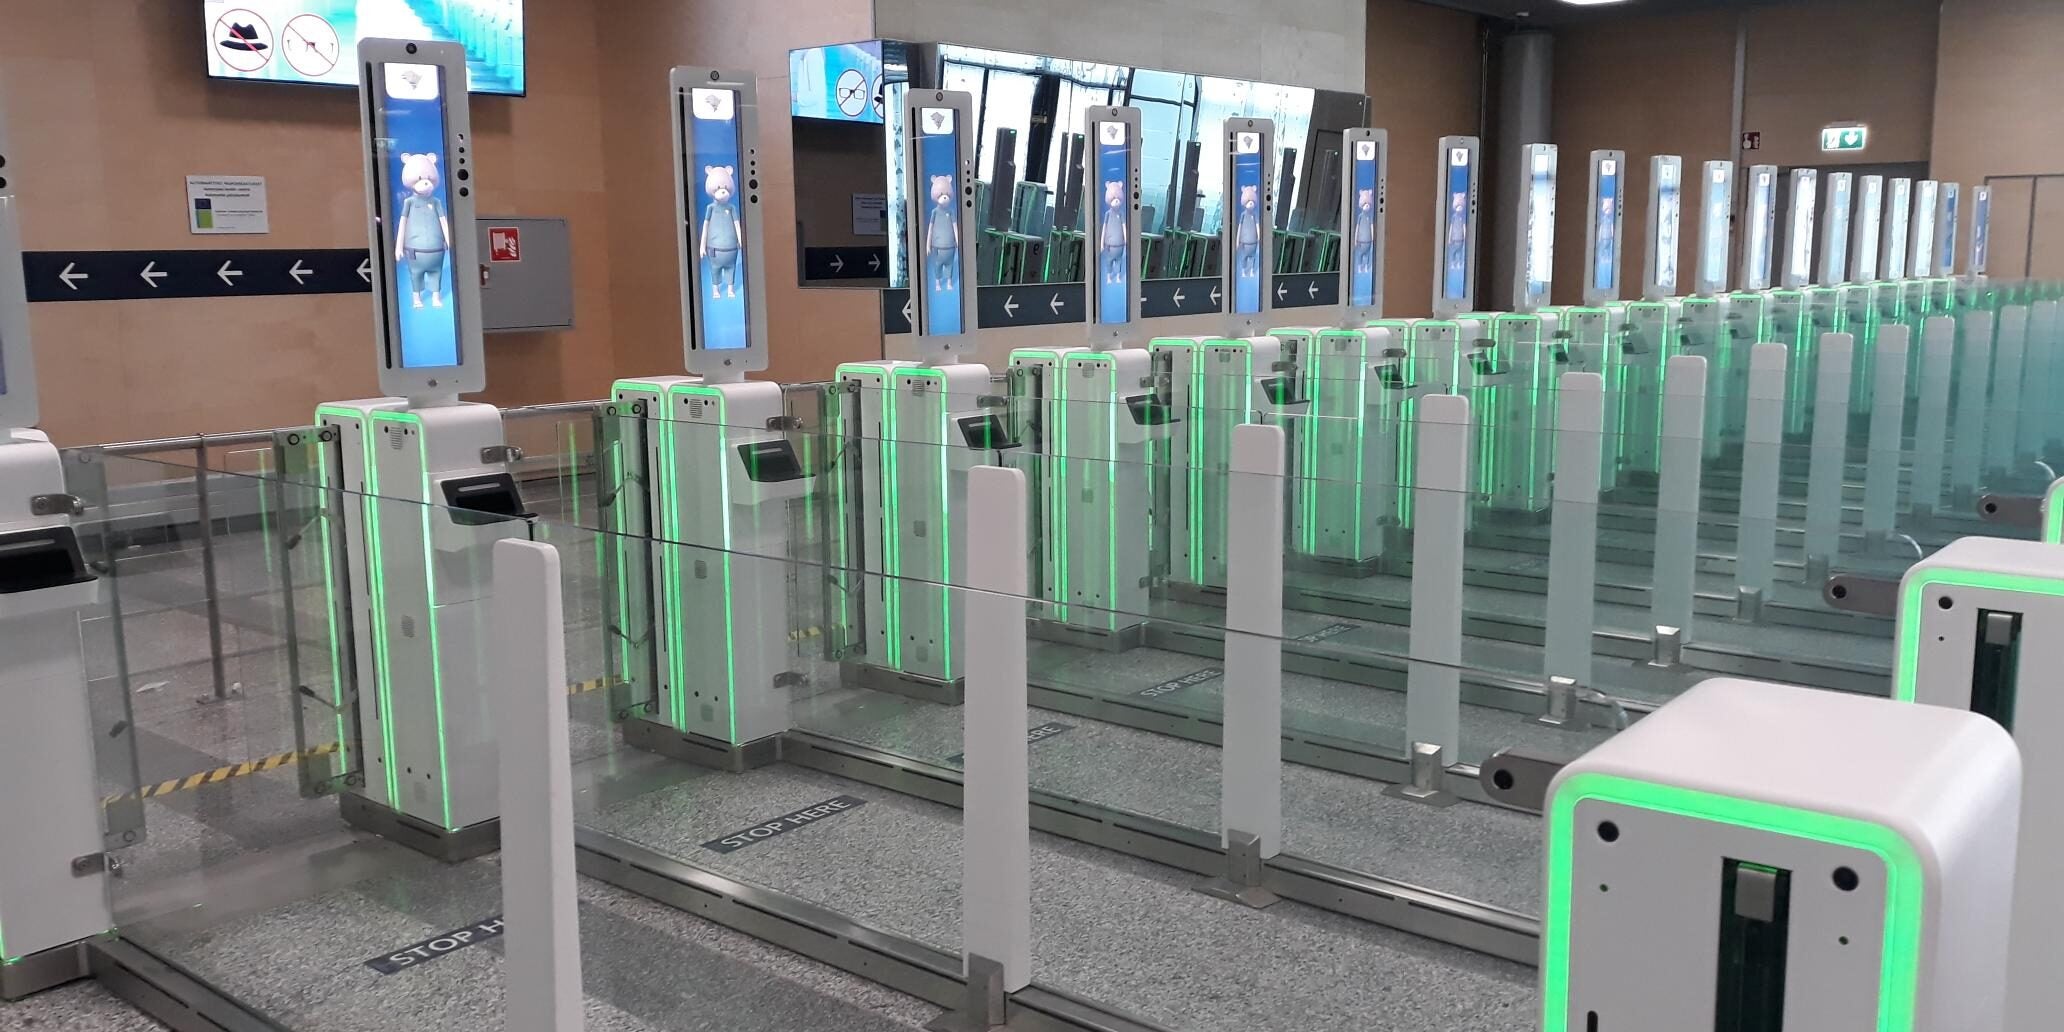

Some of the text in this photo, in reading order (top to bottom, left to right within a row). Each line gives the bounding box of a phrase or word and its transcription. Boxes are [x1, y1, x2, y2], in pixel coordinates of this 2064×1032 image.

[1140, 670, 1222, 697] STOP HERE
[1027, 726, 1061, 741] ERE
[721, 800, 852, 848] STOP HERE
[389, 930, 473, 966] STOP
